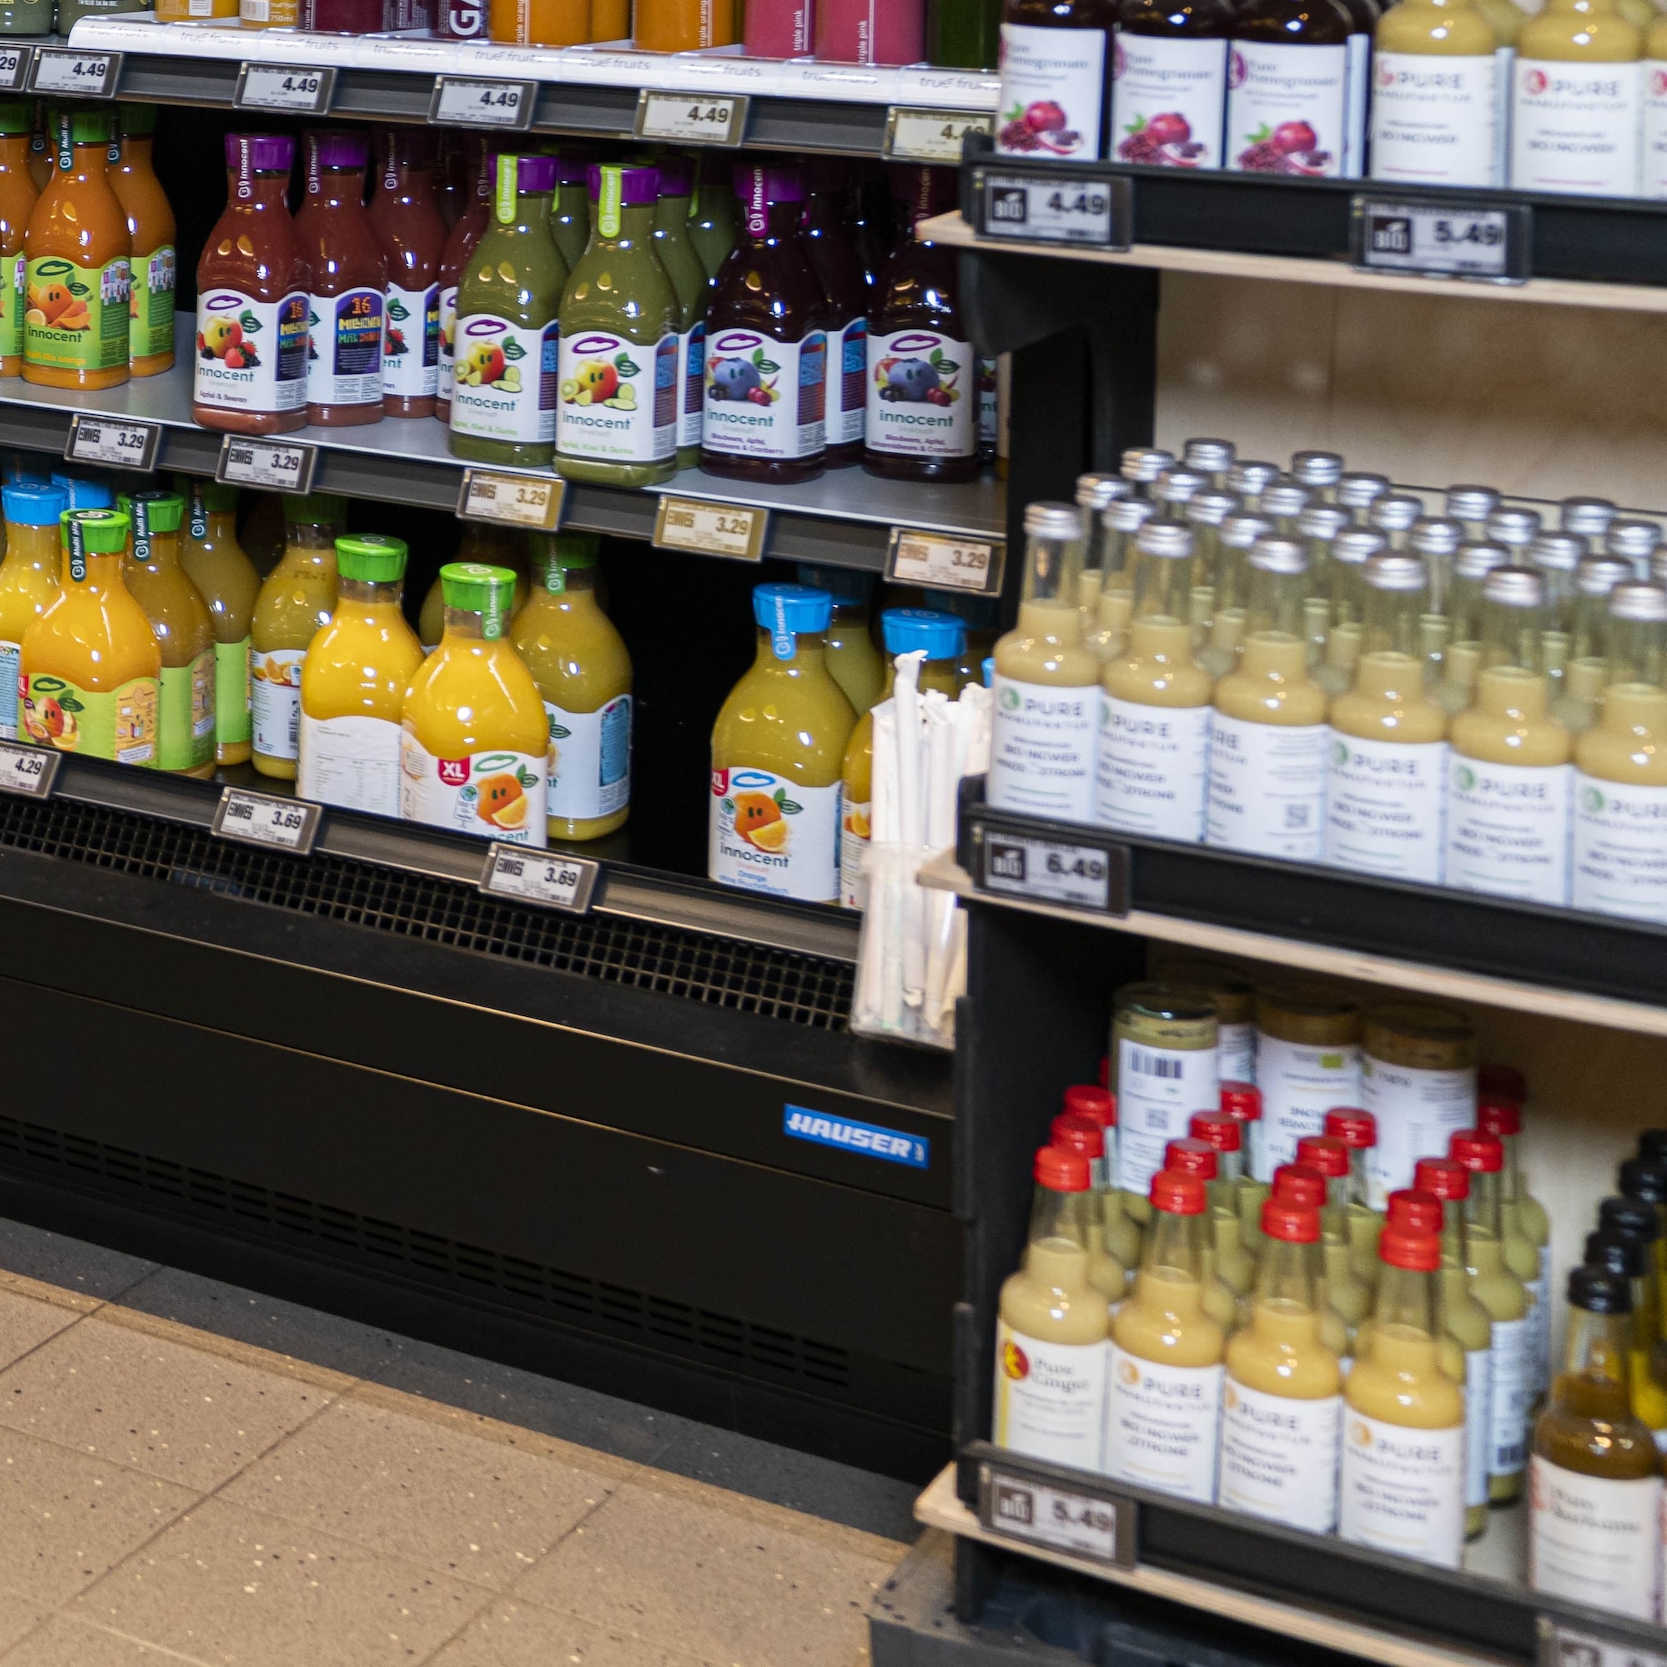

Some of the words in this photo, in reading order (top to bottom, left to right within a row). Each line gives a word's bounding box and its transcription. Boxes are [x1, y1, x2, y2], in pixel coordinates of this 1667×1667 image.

[793, 9, 803, 30] pink
[72, 61, 107, 77] 4.49
[480, 90, 519, 108] 4.49
[687, 105, 729, 123] 4.49
[1047, 190, 1108, 217] 4.49
[1435, 219, 1502, 246] 5.49
[28, 326, 83, 344] innocent
[197, 365, 255, 383] innocent
[563, 411, 632, 431] innocent
[879, 408, 955, 428] innocent
[118, 432, 144, 449] 3.29
[517, 488, 547, 506] 3.29
[1023, 698, 1087, 719] PURE
[14, 757, 43, 774] 4.29
[442, 759, 466, 779] XL
[720, 842, 790, 868] innocent
[544, 864, 577, 887] 3.69
[1046, 853, 1108, 881] 6.49
[786, 1111, 914, 1159] HAUSER
[1052, 1499, 1113, 1532] 5.49
